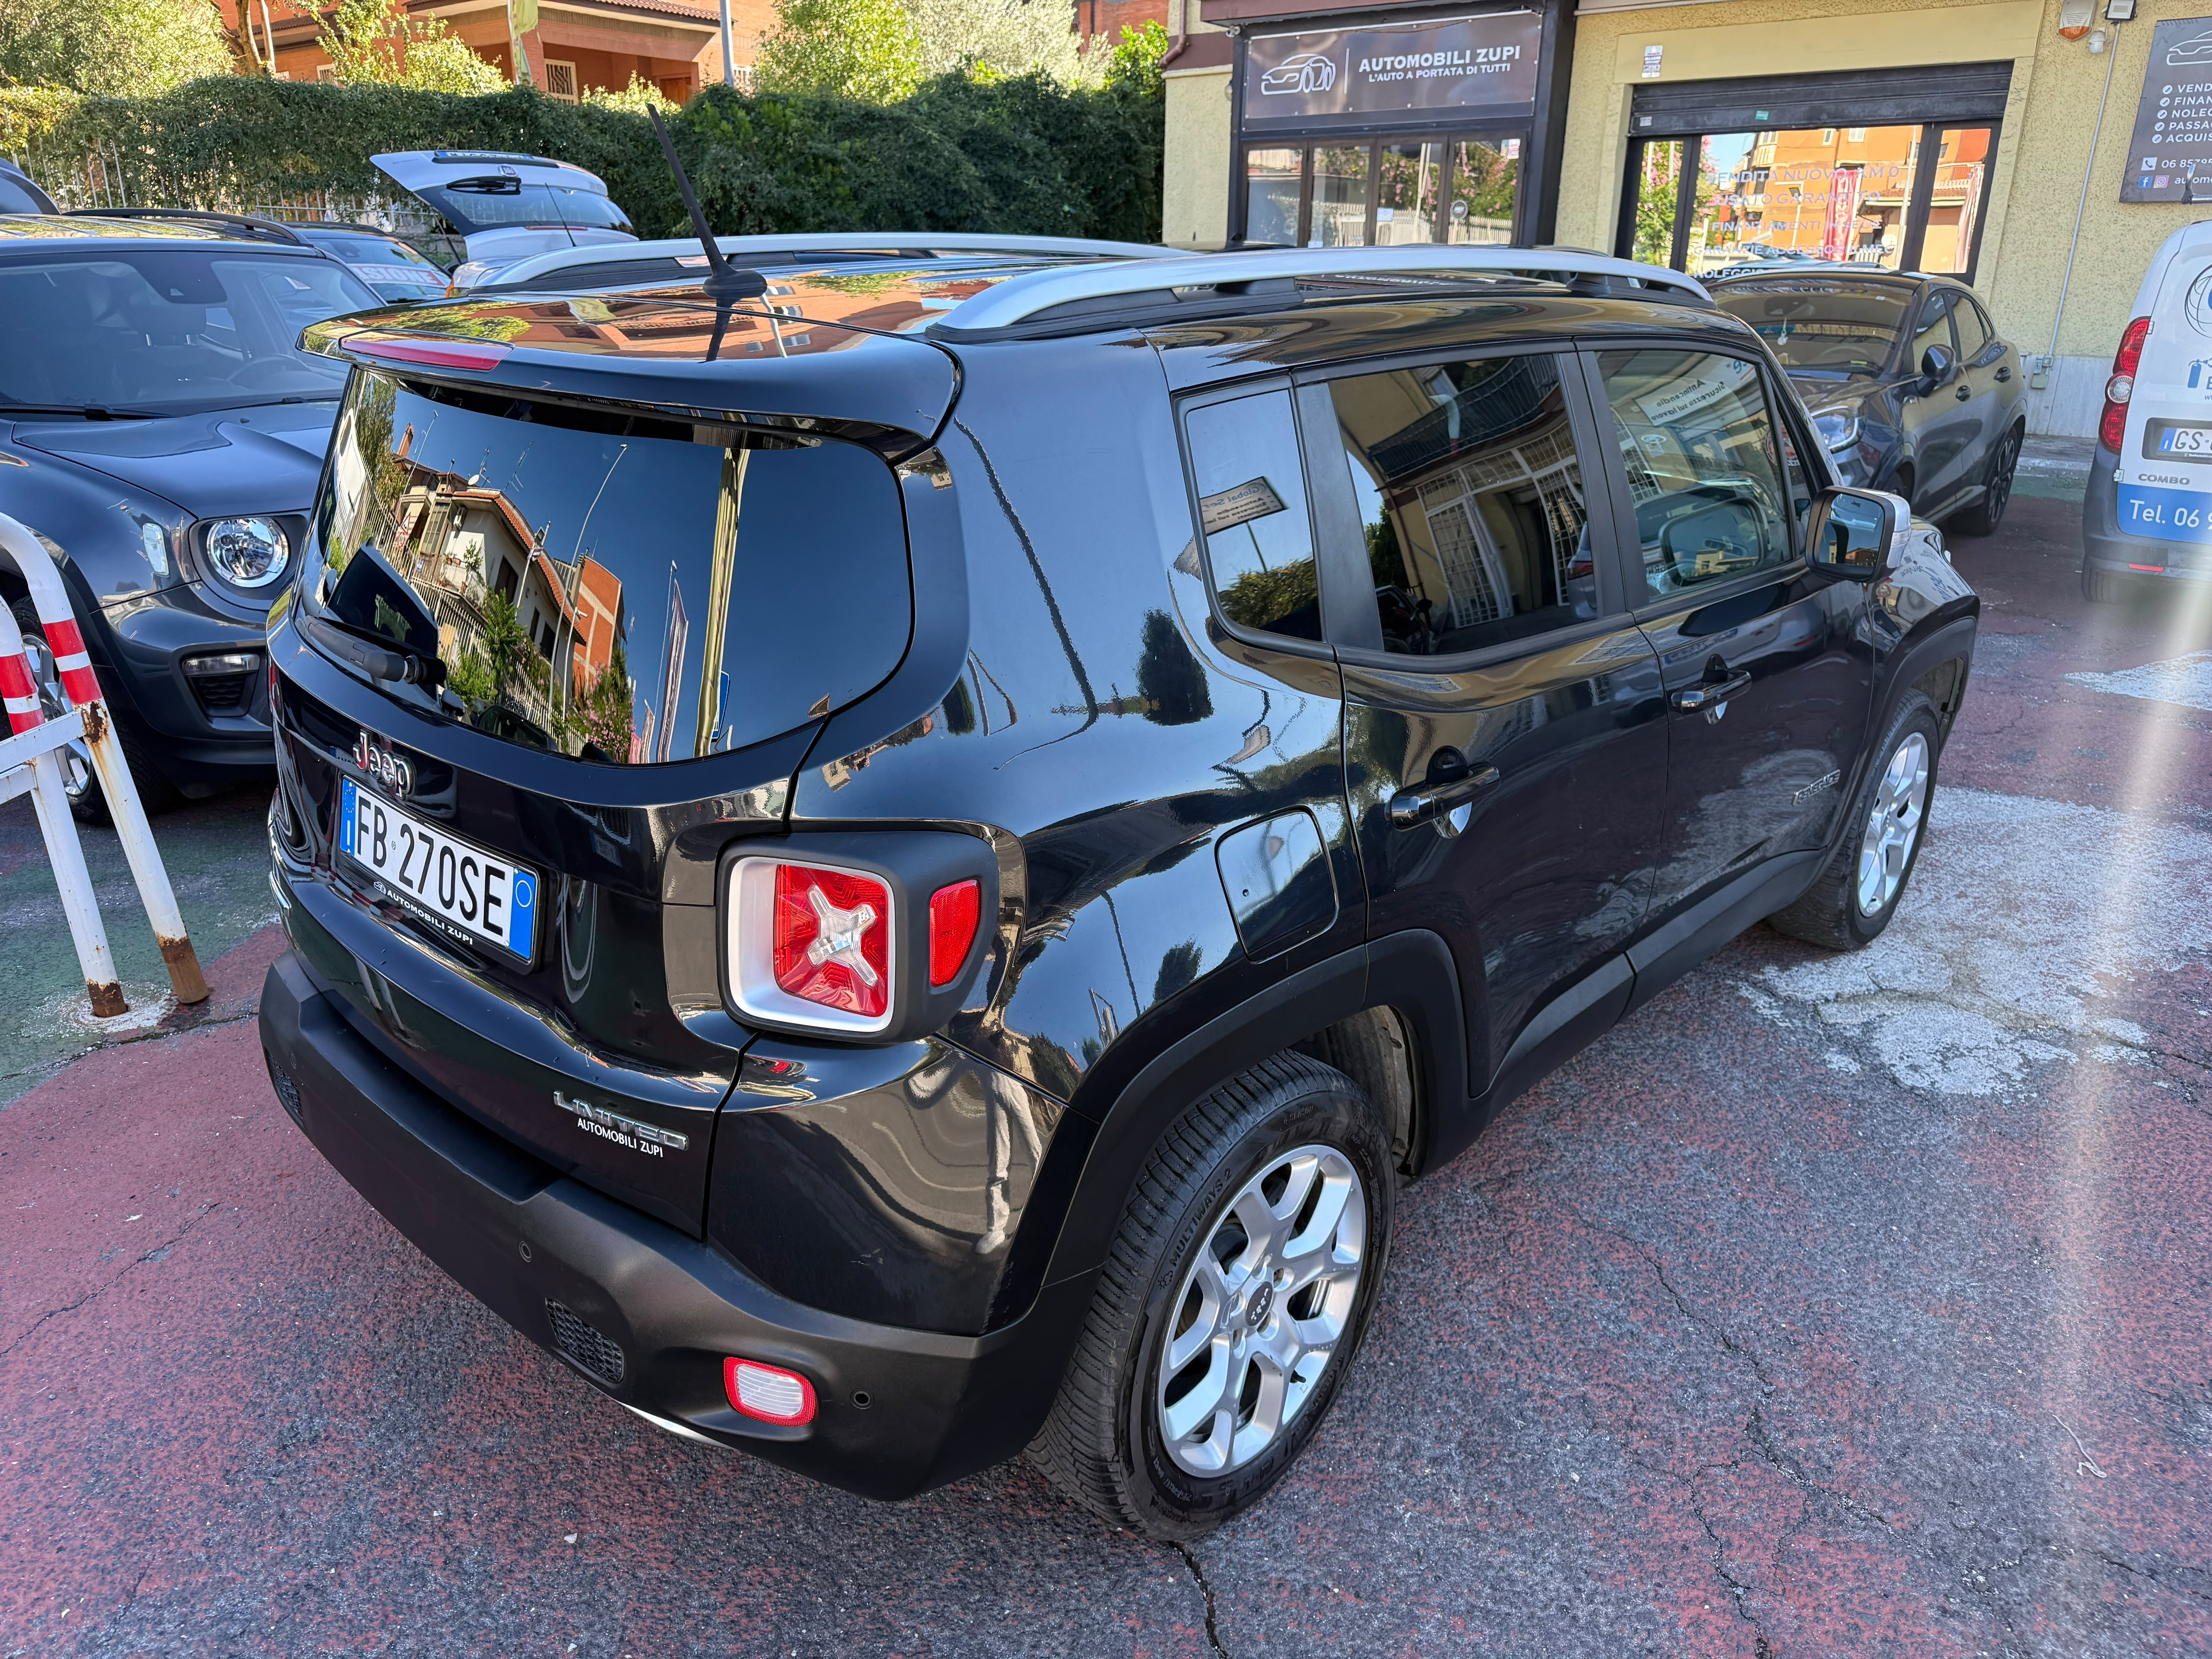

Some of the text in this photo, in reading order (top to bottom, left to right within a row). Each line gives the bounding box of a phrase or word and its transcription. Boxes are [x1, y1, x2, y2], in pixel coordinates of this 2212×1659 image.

[1358, 45, 1521, 72] AUTOMOBILI ZUPI
[1369, 63, 1511, 83] L'AUTO A PORTATA DI TUTTI
[2178, 83, 2212, 93] VEND
[2174, 96, 2212, 105] FINAN
[2169, 121, 2212, 130] PASSA
[2161, 160, 2176, 168] 06
[1707, 170, 1778, 184] VENDITA
[1784, 168, 1847, 181] NUOVO
[1717, 191, 1880, 206] USATO GARANTTO
[2139, 474, 2190, 485] COMBO
[2130, 499, 2166, 524] Tel.
[2174, 508, 2199, 528] 06
[353, 729, 416, 800] Jeep
[357, 795, 388, 868] FB
[398, 823, 506, 937] 270SE
[387, 890, 474, 946] AUTOMOBILI ZUPI
[553, 1090, 689, 1150] LIMITED
[577, 1117, 664, 1158] AUTOMOBILI ZUPI
[1170, 1178, 1224, 1267] MULTIWAYS
